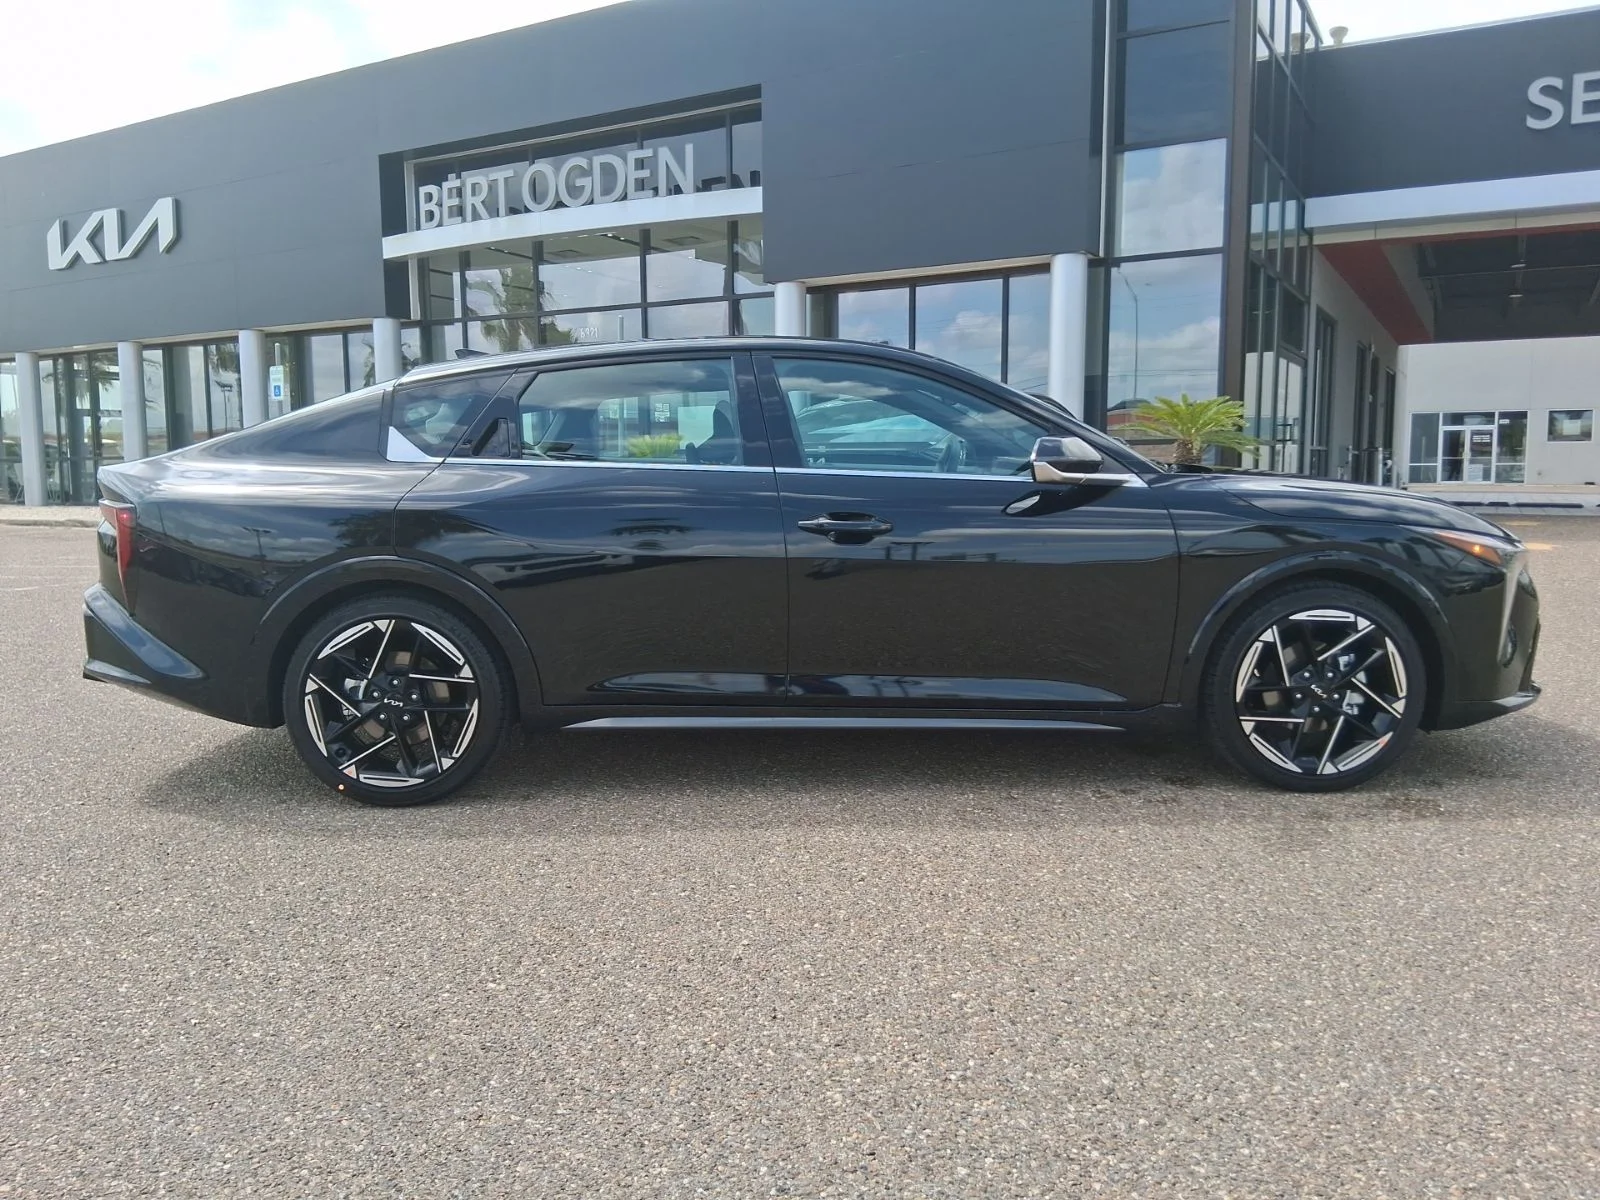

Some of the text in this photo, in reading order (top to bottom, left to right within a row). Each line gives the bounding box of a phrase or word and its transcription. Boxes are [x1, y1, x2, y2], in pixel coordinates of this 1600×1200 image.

[1526, 70, 1600, 130] SE
[418, 143, 694, 231] BERT OGDEN
[47, 196, 177, 271] KIA
